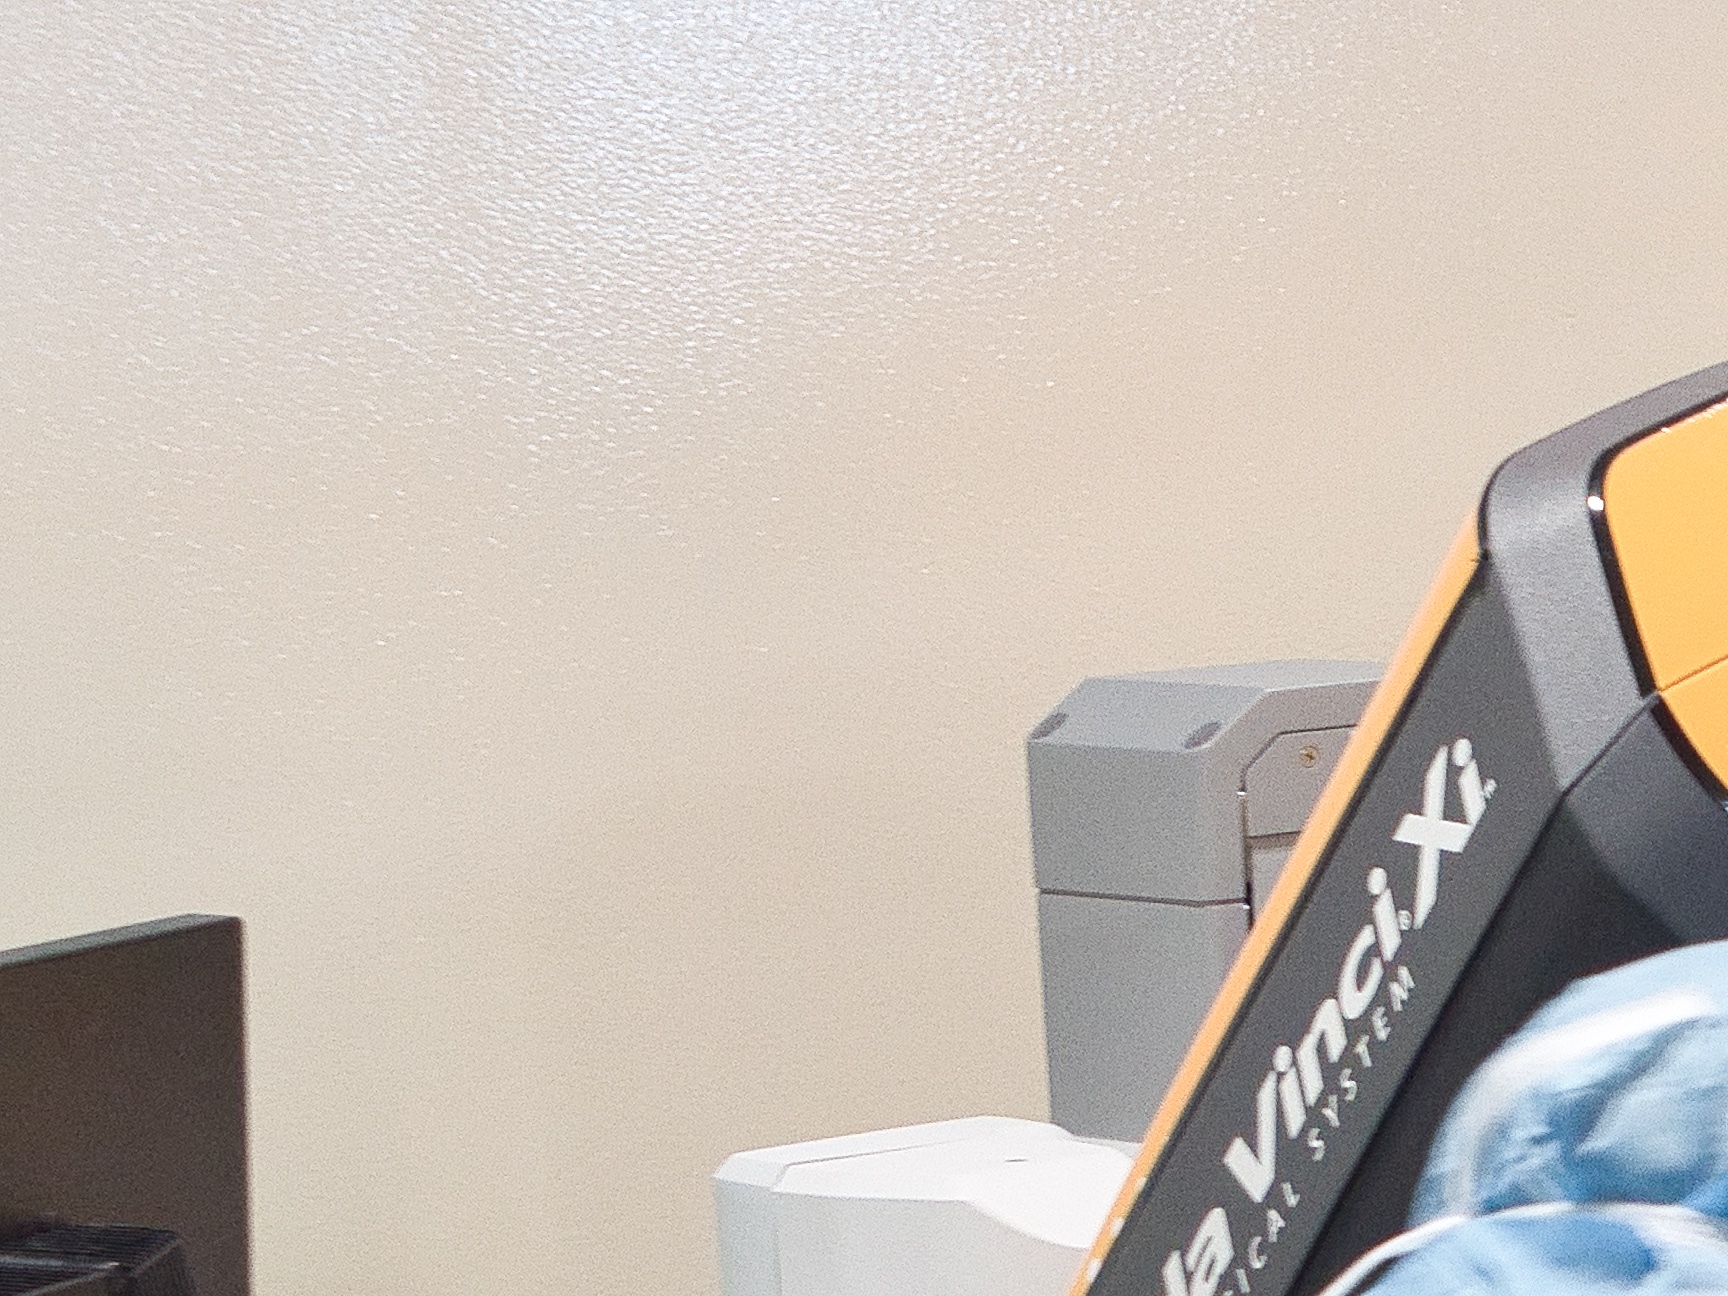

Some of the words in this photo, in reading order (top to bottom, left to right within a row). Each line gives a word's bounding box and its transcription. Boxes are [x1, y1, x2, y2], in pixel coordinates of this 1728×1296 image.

[1223, 866, 1402, 1203] Vinci
[1392, 737, 1487, 931] Xi
[1306, 964, 1416, 1162] SYSTEM
